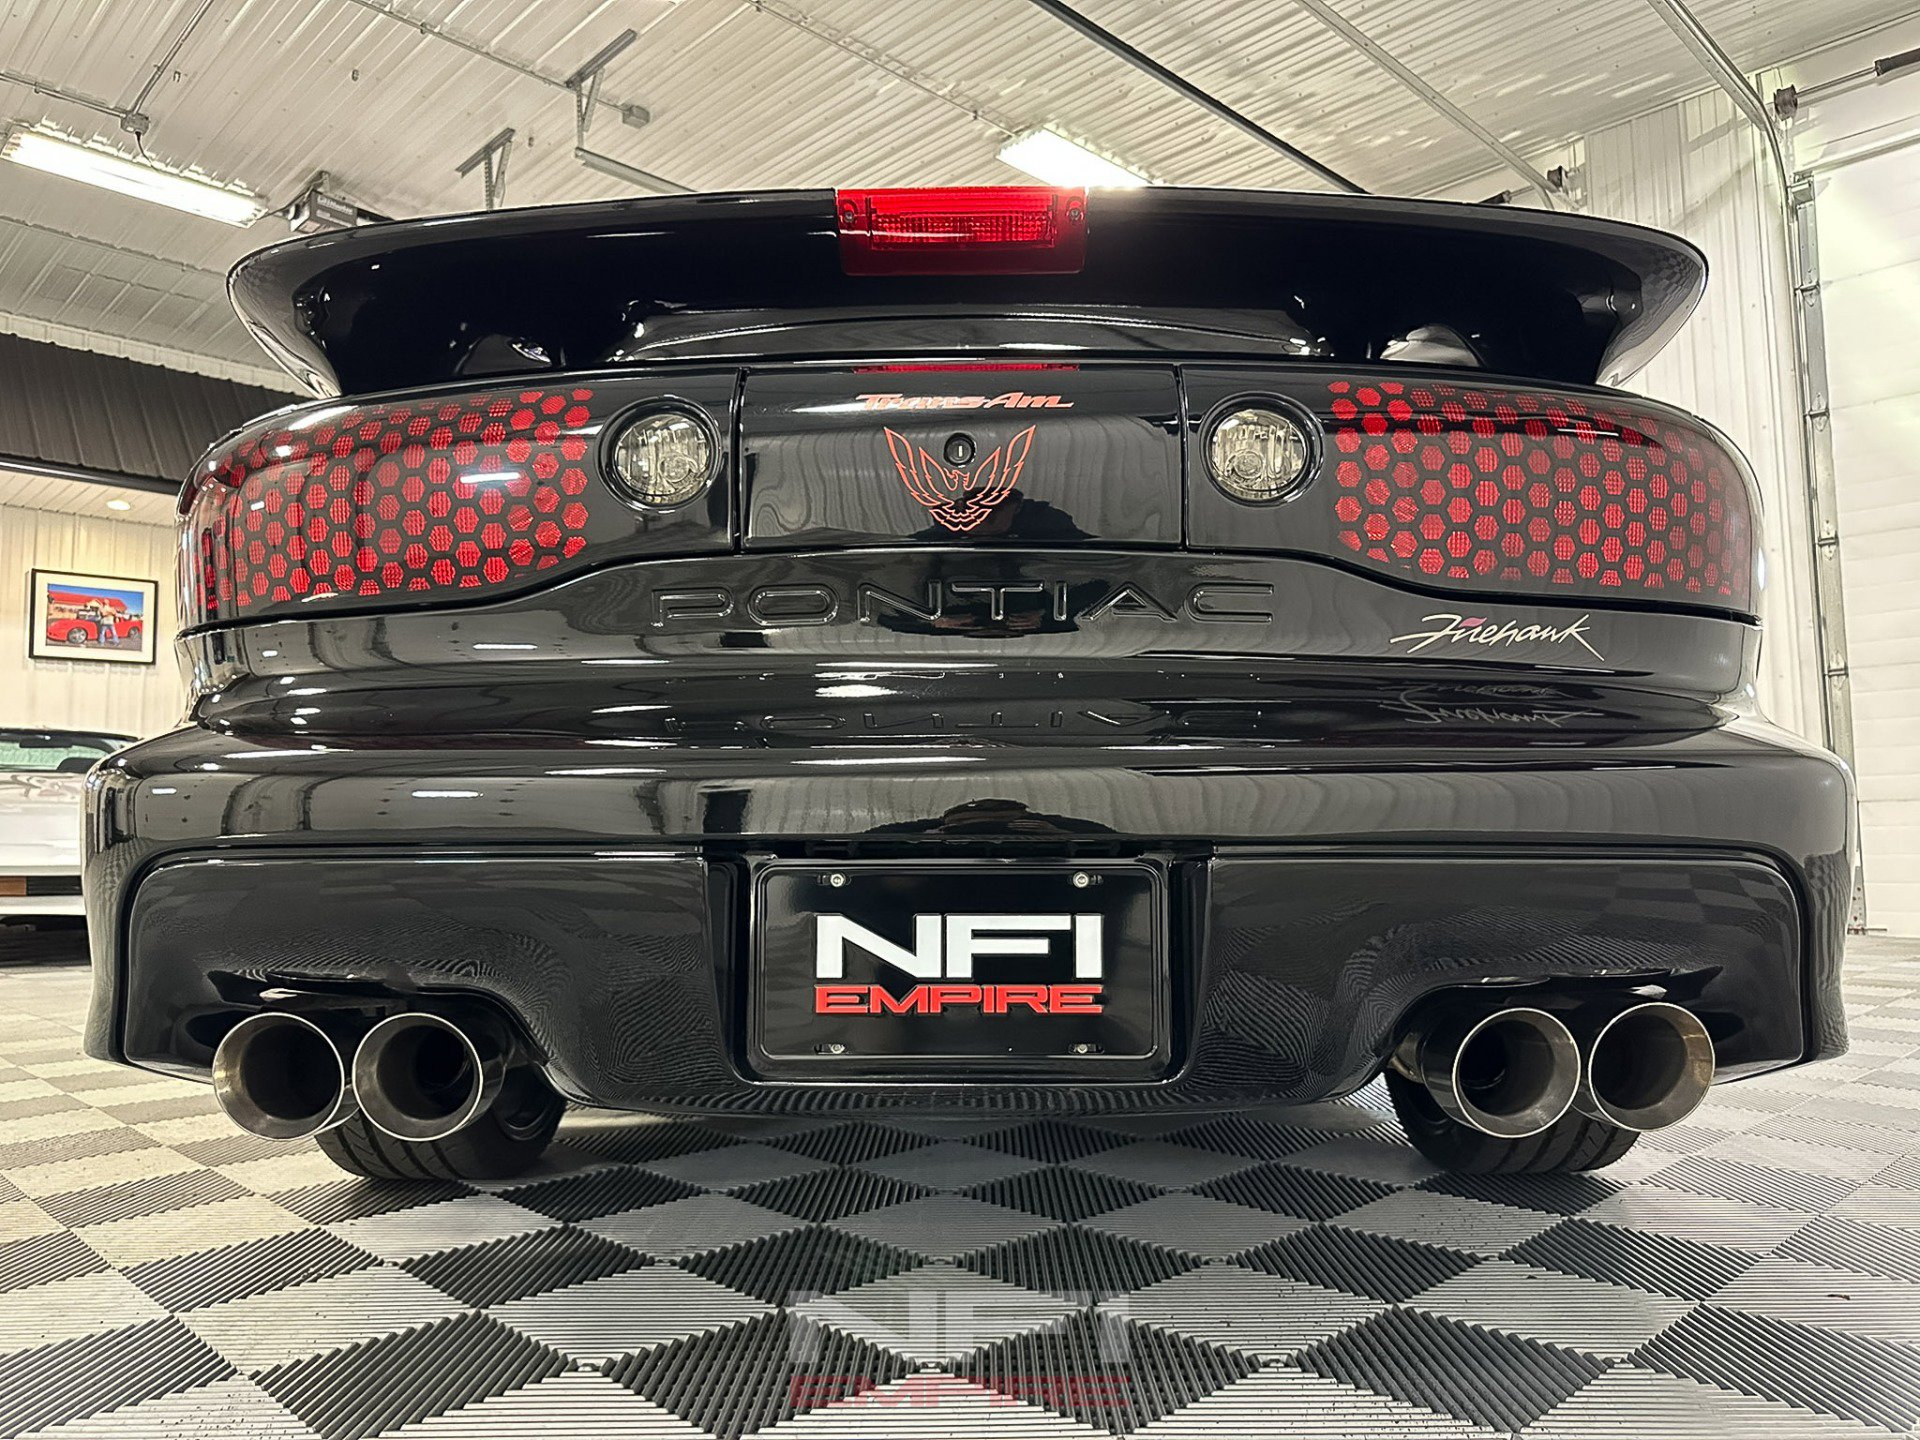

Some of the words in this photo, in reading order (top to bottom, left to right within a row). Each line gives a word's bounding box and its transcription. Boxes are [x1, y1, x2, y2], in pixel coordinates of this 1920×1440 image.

[649, 581, 1275, 628] PONTIAC
[1389, 613, 1605, 662] Firehawk
[815, 913, 1104, 979] NFI
[815, 984, 1104, 1014] EMPIRE
